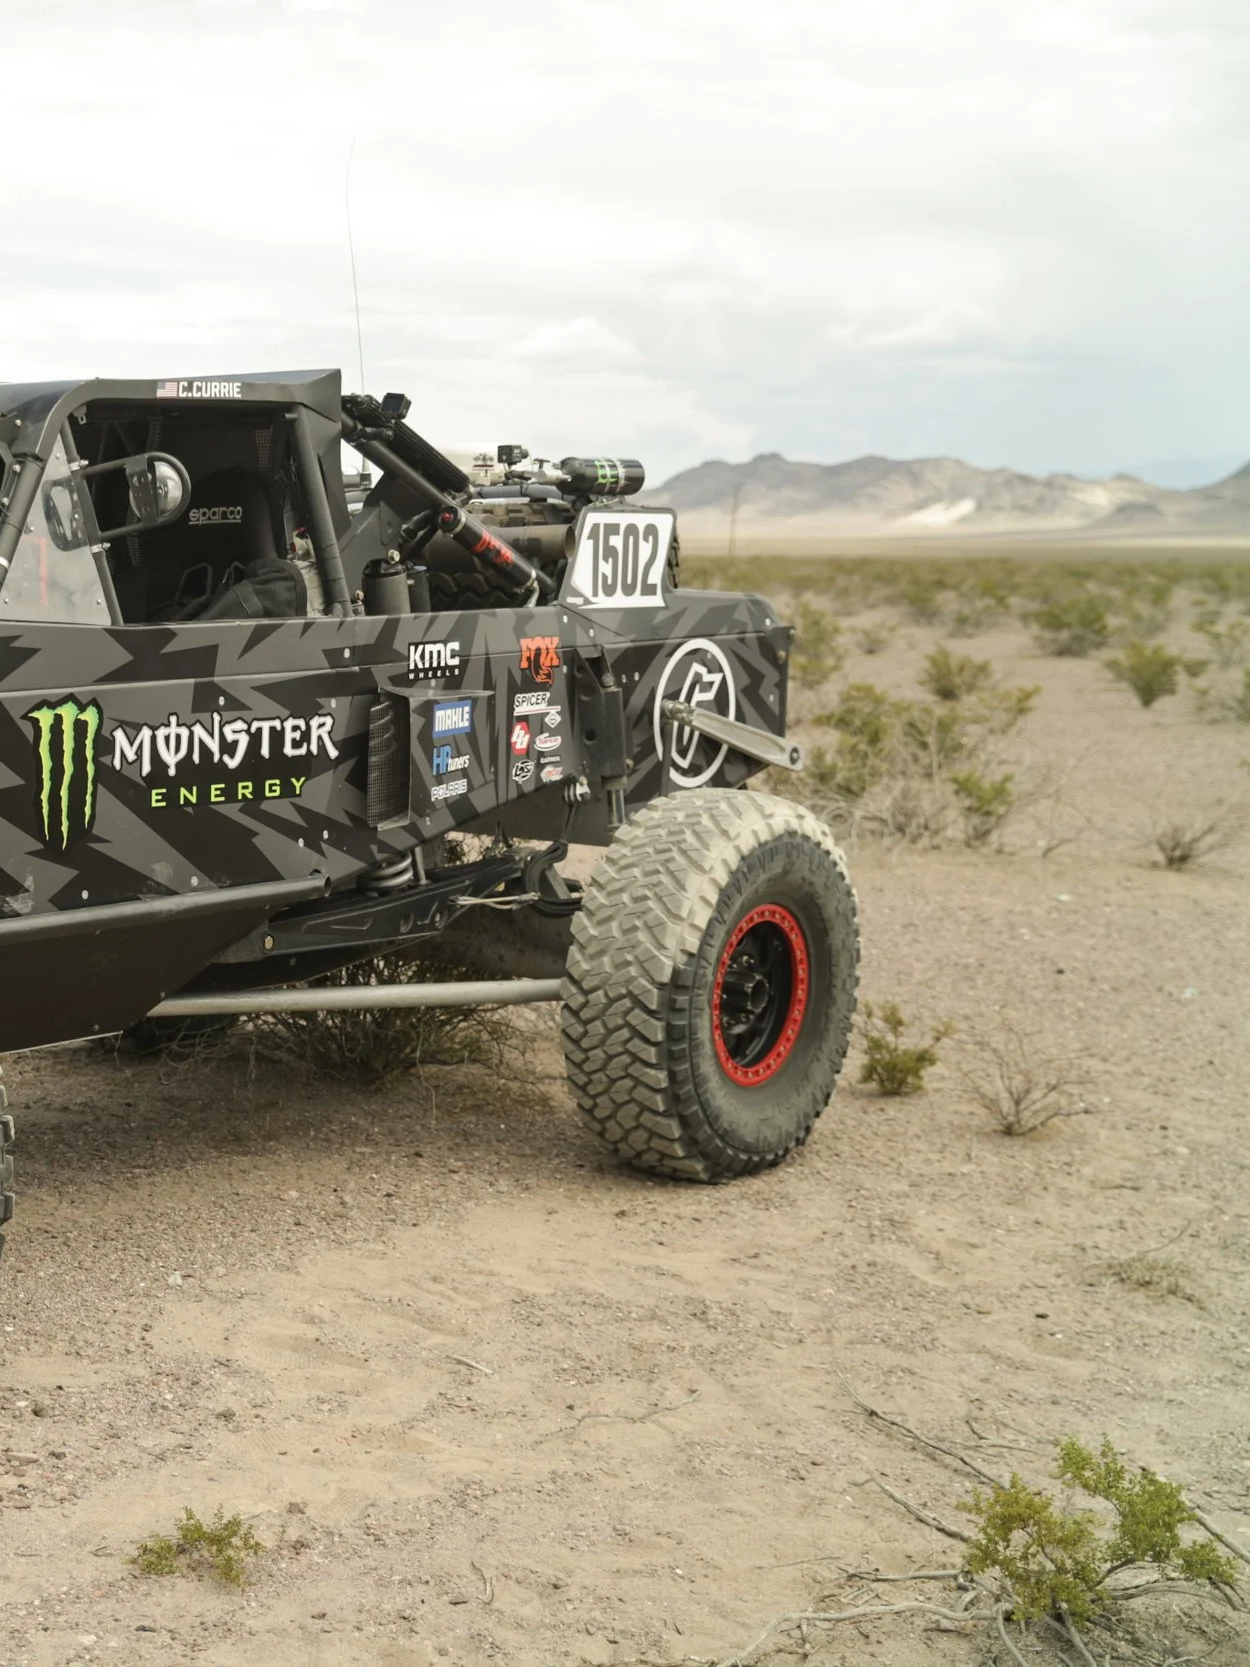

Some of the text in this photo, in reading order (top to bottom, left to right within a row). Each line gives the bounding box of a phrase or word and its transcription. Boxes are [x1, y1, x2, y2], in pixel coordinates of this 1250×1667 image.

[179, 381, 242, 398] C.CURRIE
[189, 506, 243, 523] sparco
[587, 523, 659, 598] 1502
[409, 641, 460, 669] KMC
[408, 668, 459, 680] WHEELS
[514, 693, 548, 708] SPICER
[435, 706, 470, 732] MAHLE
[111, 711, 340, 777] MONSTER
[151, 777, 306, 807] ENERGY
